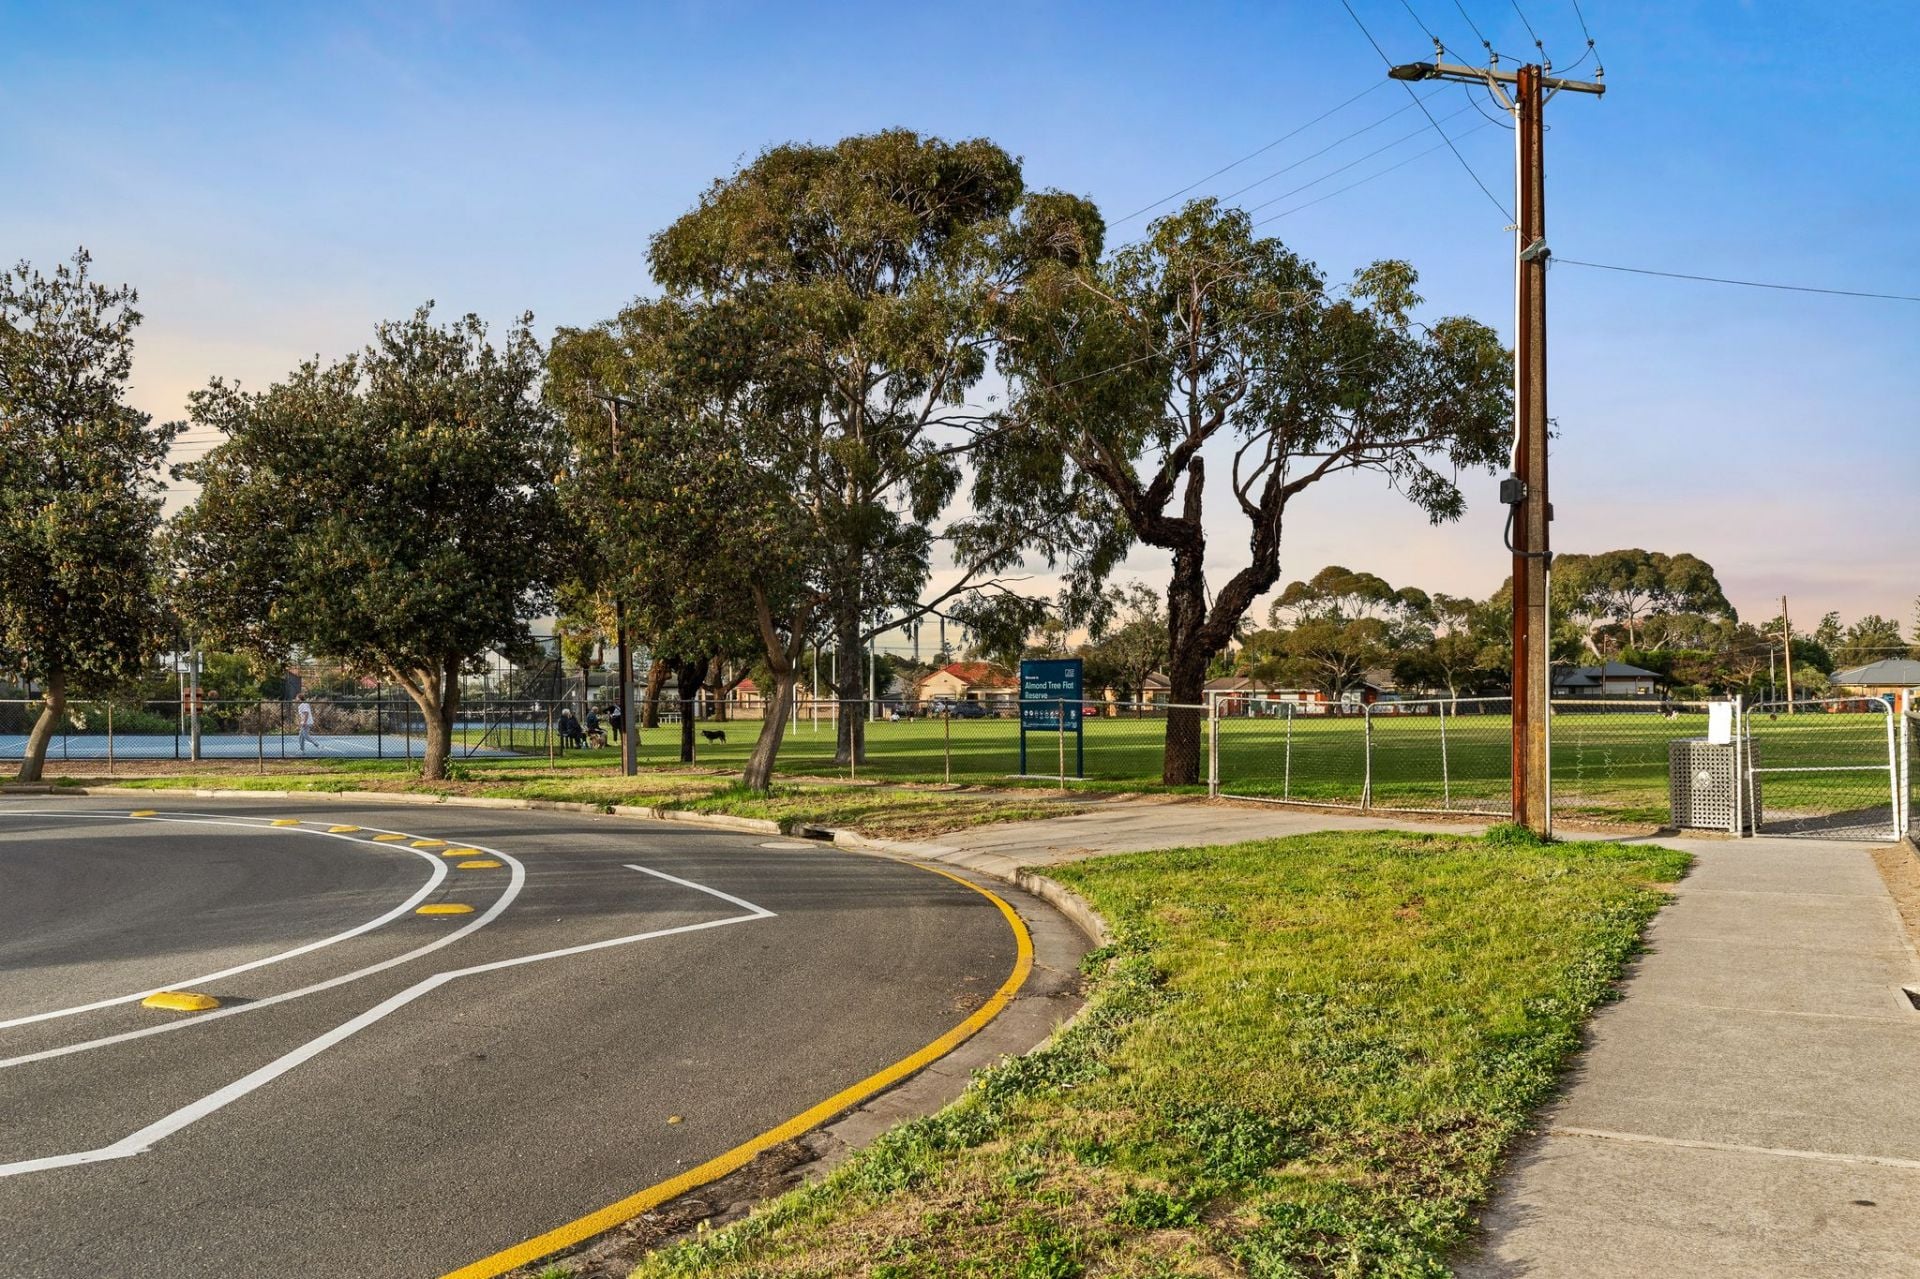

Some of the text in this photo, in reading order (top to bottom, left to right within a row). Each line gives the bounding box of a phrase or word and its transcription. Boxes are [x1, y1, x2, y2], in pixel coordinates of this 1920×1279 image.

[1025, 681, 1074, 689] Almond Tree Flat
[1025, 691, 1048, 699] Reserve
